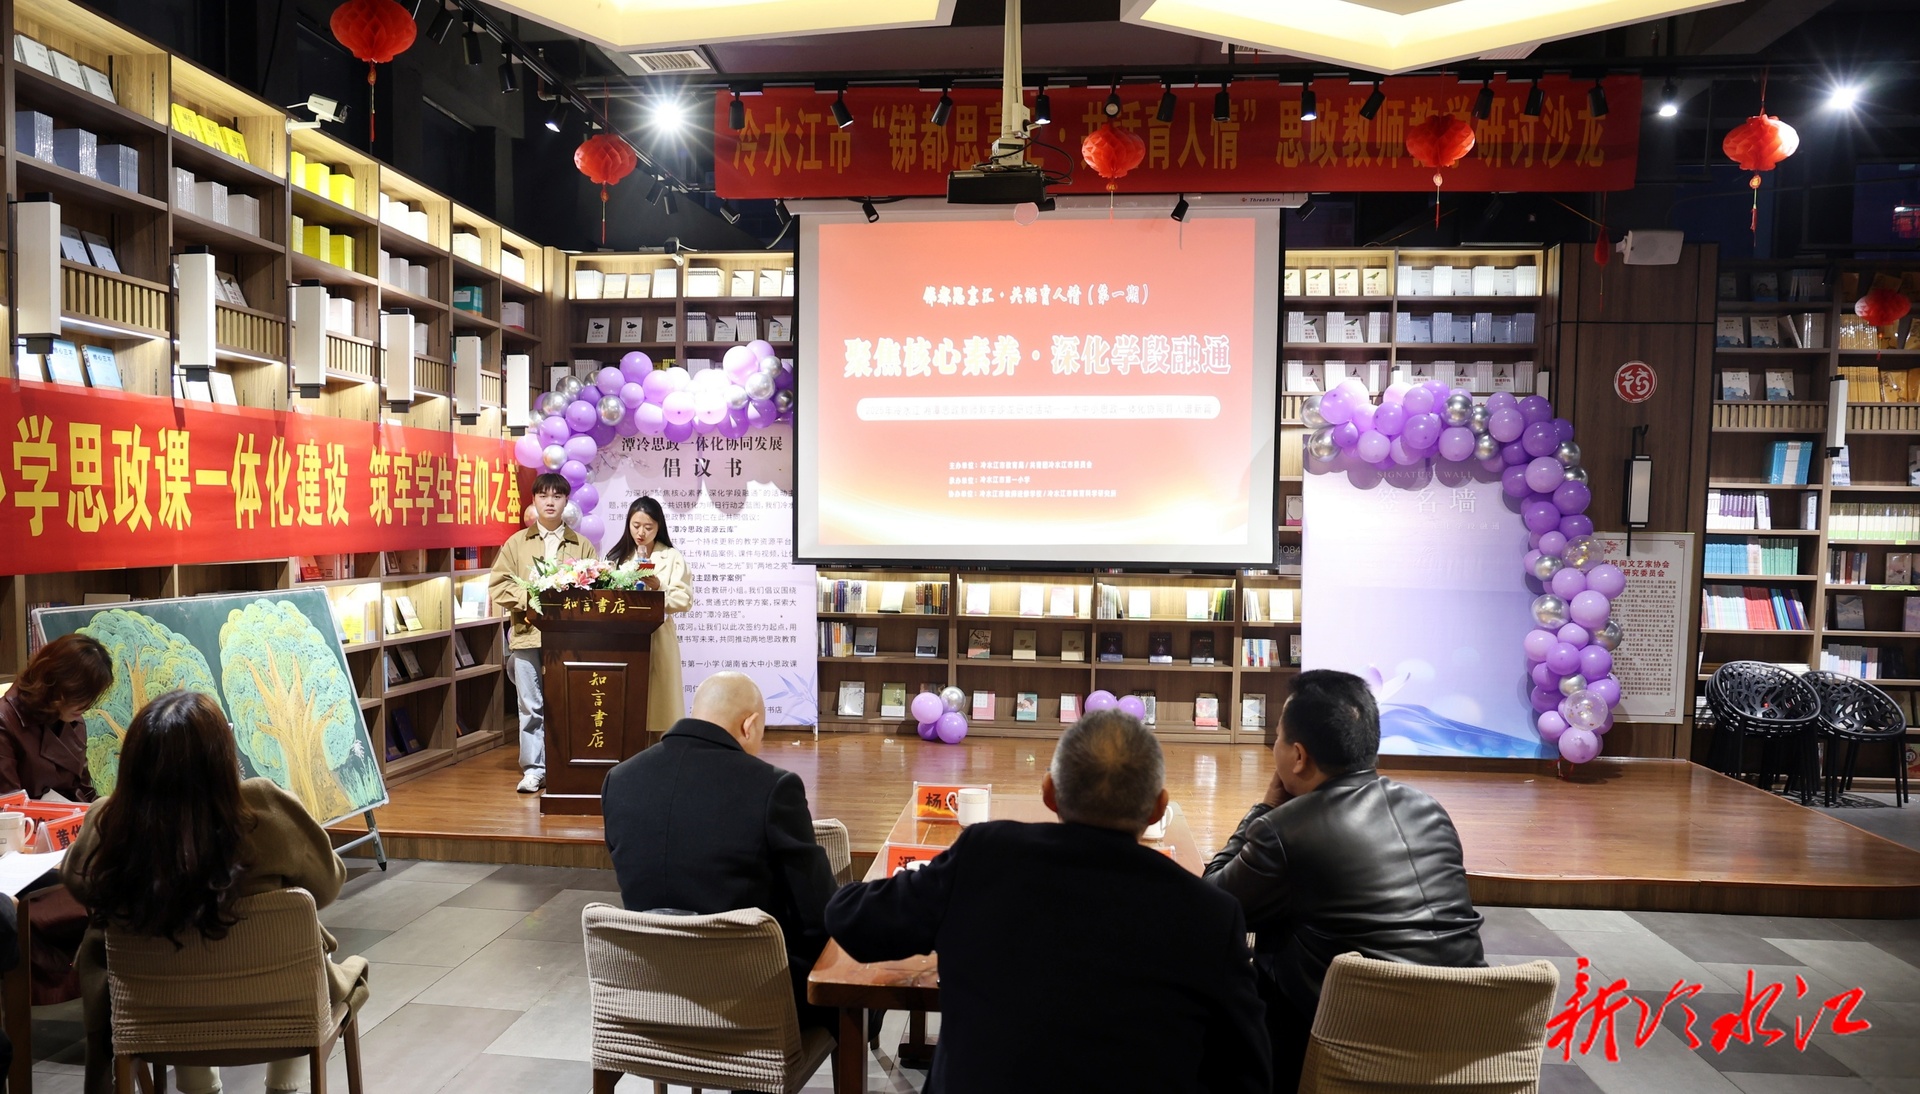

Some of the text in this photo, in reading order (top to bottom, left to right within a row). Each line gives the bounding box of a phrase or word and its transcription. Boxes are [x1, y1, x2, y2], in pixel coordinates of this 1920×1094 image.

[732, 106, 851, 176] 冷水江市
[843, 333, 1232, 378] 聚焦核心素养·深化学段融通
[621, 436, 783, 451] 潭冷思政一体化协同发展
[0, 414, 521, 537] 学思政课一体化建设 筑牢学生信仰之基
[662, 457, 743, 478] 倡议书
